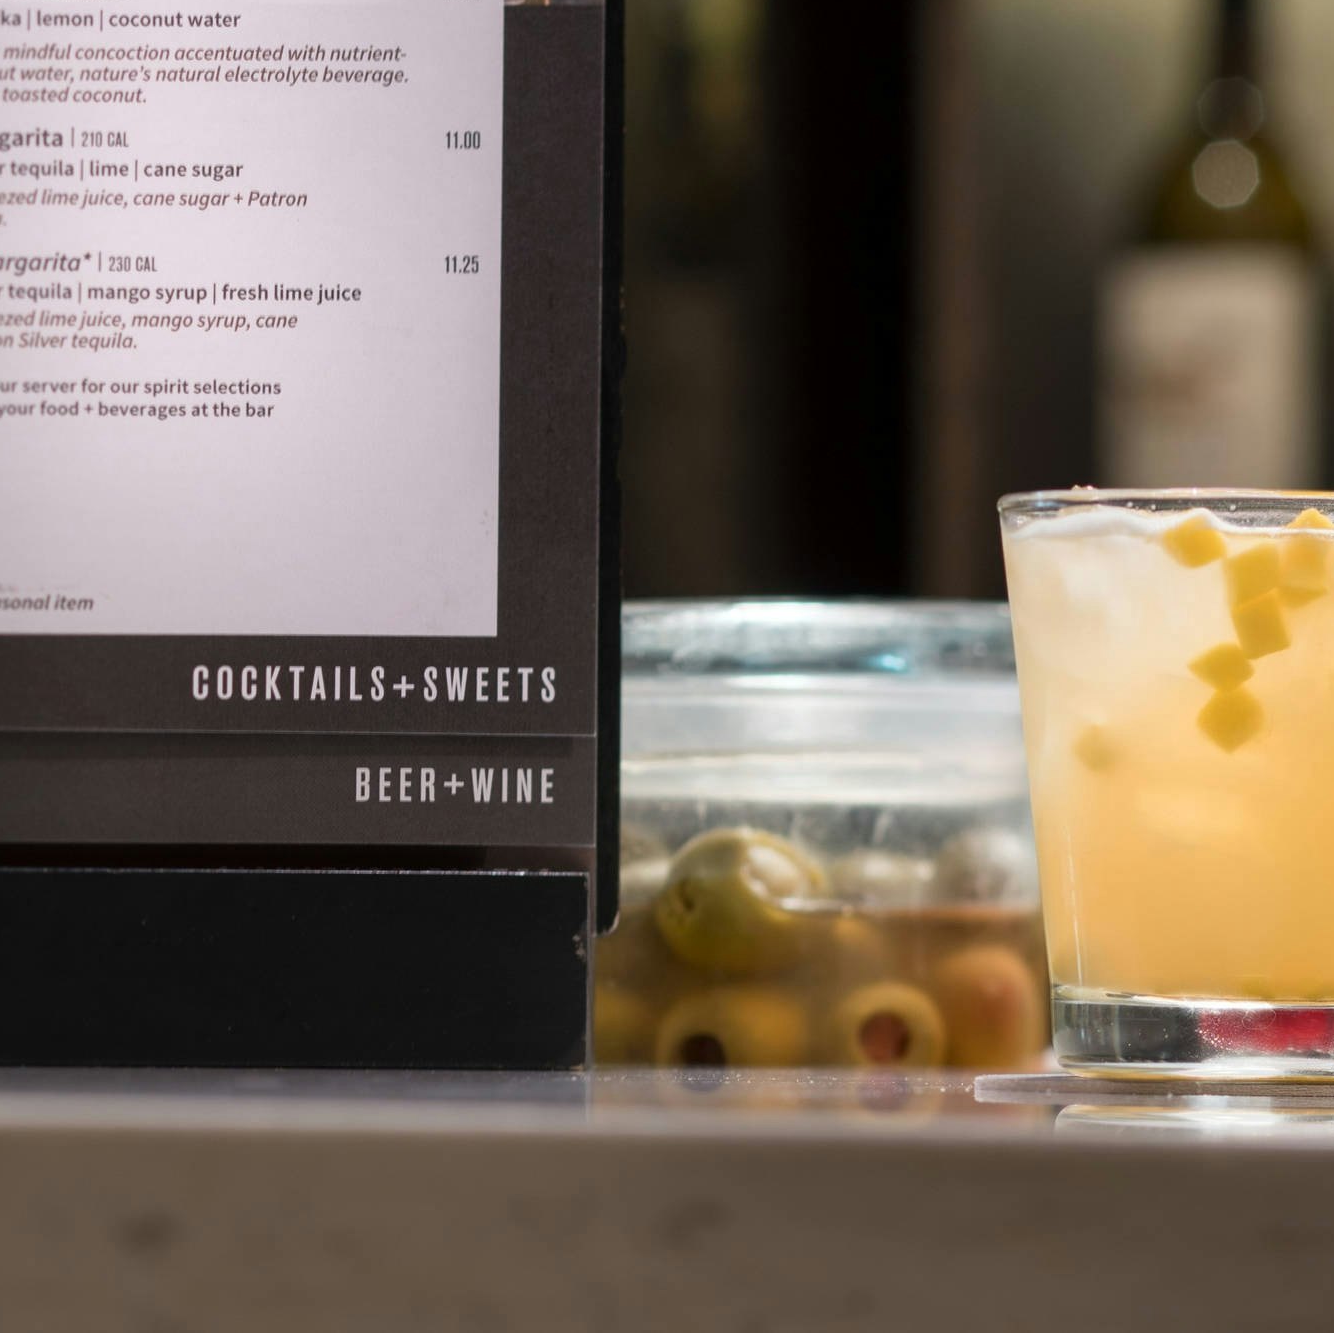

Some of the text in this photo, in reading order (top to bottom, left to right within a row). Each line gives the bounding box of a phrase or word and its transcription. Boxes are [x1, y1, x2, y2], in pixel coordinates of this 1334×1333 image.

[35, 10, 242, 27] lemon coconut water
[73, 45, 406, 62] concoction accentuated with nutrient-
[154, 66, 223, 82] natural
[223, 66, 320, 86] electrolyte
[321, 66, 409, 87] beverage.
[71, 88, 147, 103] coconut.
[80, 131, 104, 147] 210
[106, 132, 131, 147] CAL
[445, 131, 482, 149] 11.00
[9, 160, 244, 181] tequila lime cane sugar
[80, 189, 308, 210] juice, cane sugar Patron
[107, 255, 159, 272] 230 CAL
[444, 255, 480, 274] 11.25
[6, 283, 362, 304] tequila mango syrup fresh lime juice
[78, 311, 299, 332] juice, mango syrup, cane
[70, 332, 138, 352] tequila.
[79, 378, 282, 397] for our spirit selections
[96, 402, 275, 421] beverages at the bar
[53, 595, 95, 610] item
